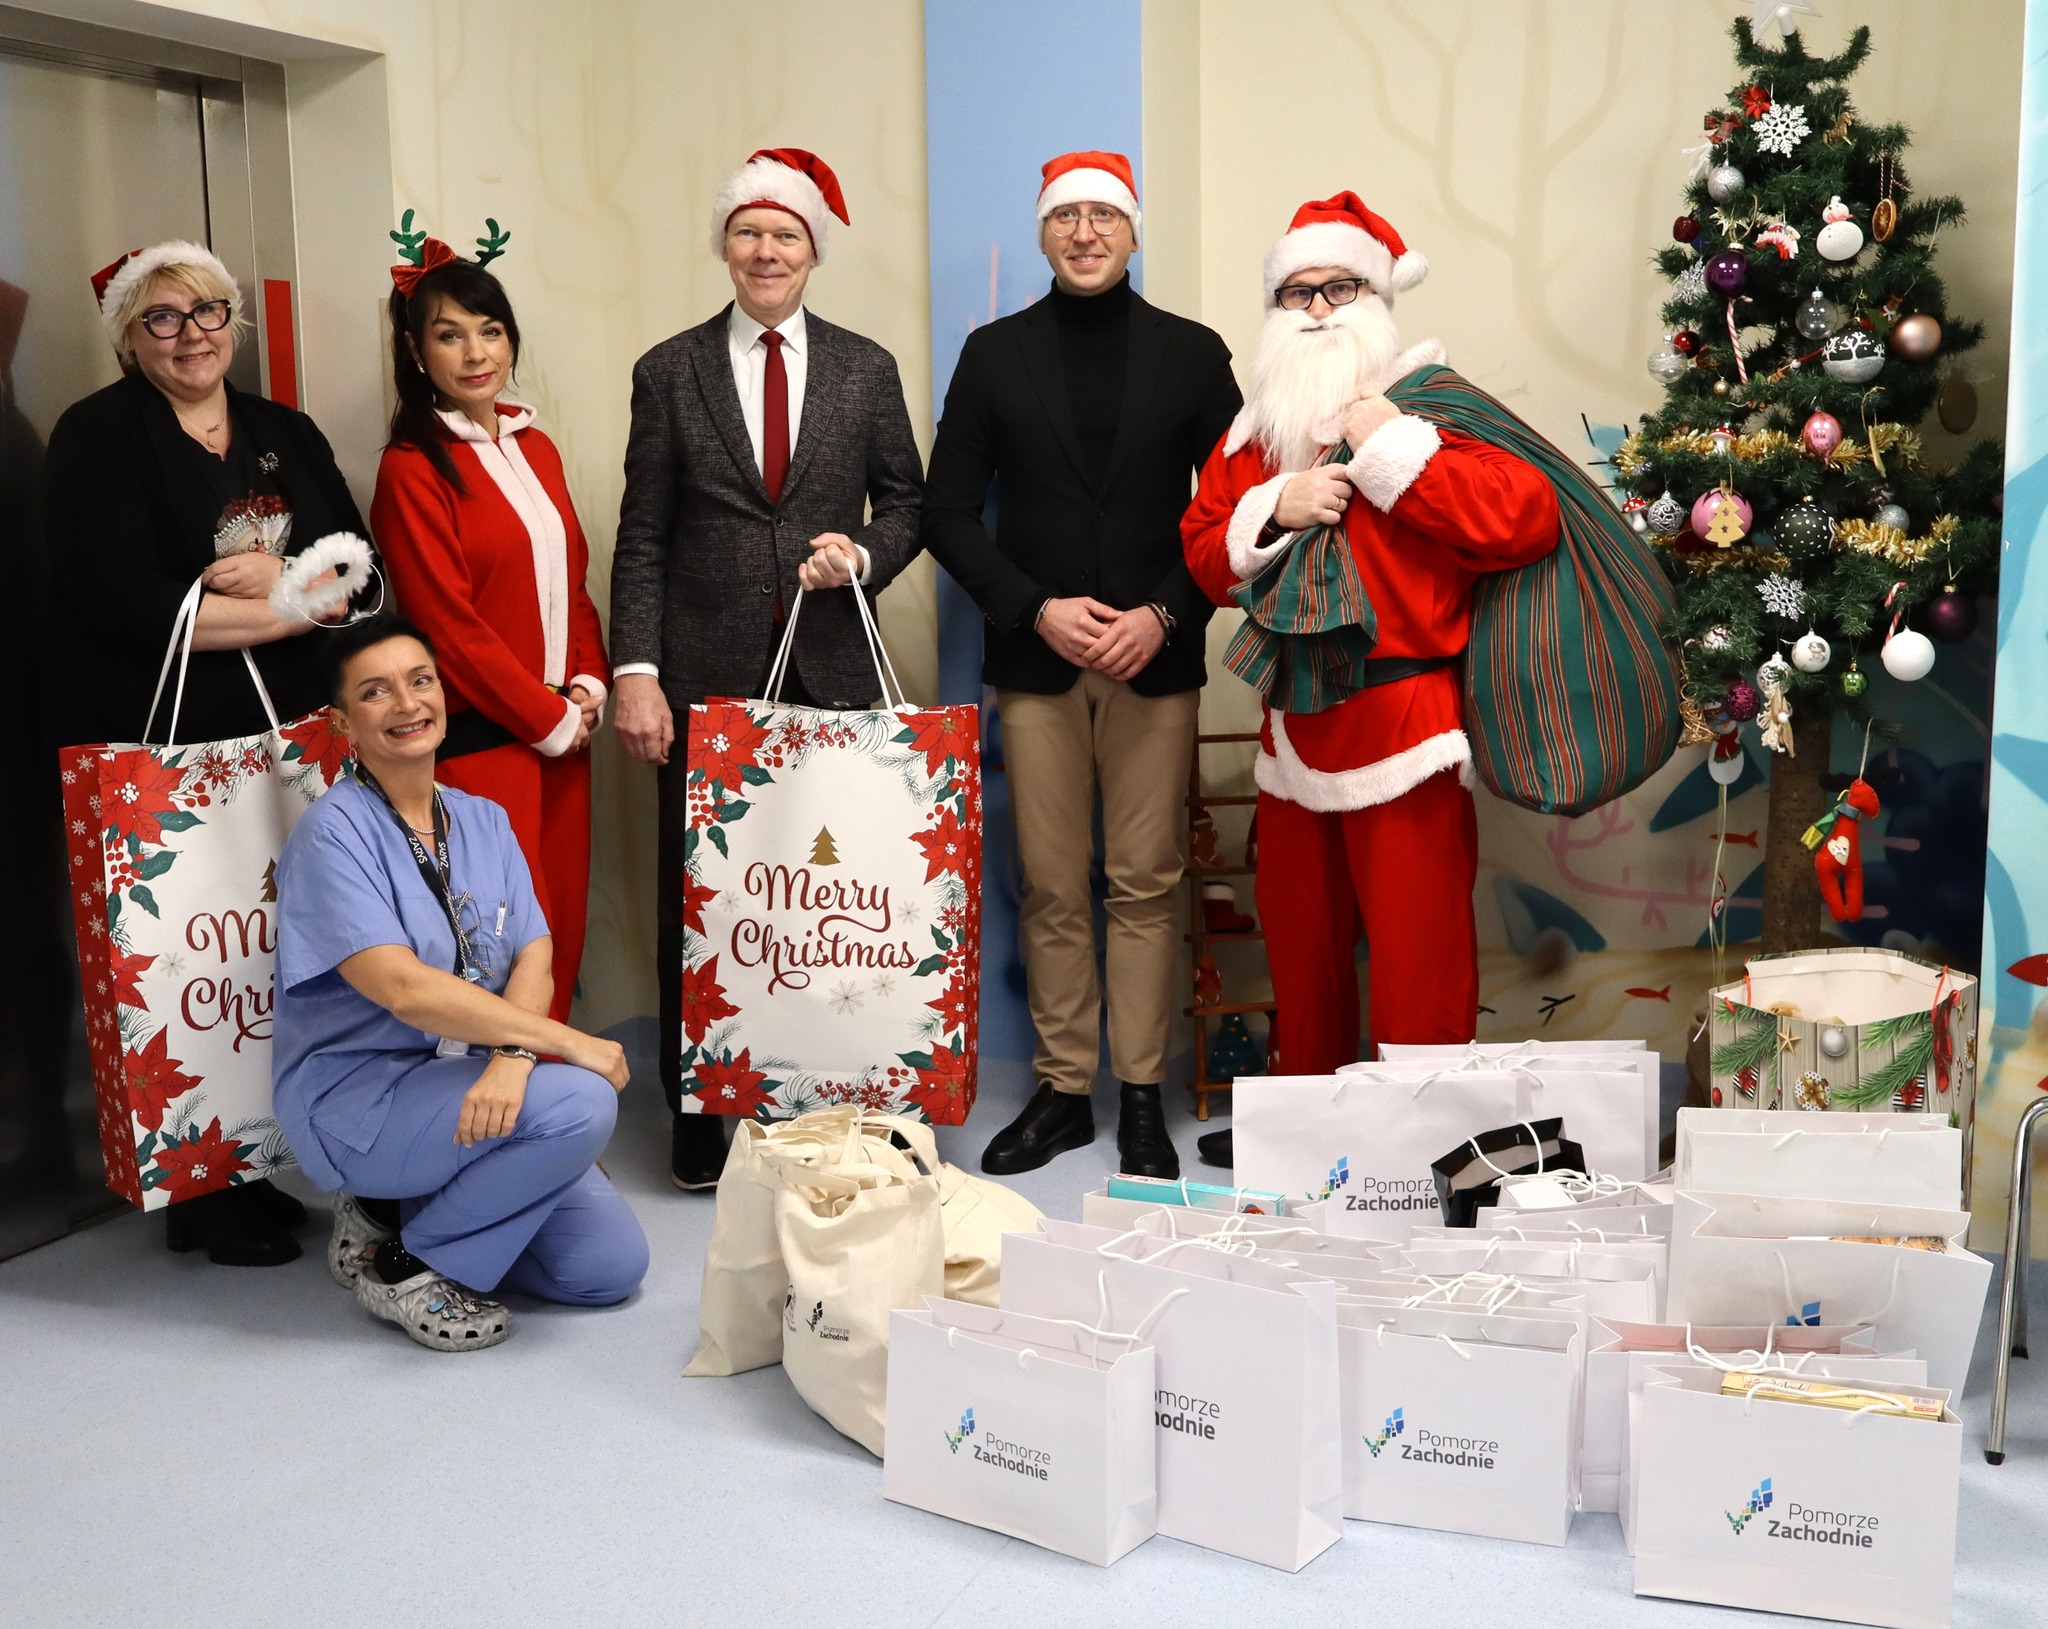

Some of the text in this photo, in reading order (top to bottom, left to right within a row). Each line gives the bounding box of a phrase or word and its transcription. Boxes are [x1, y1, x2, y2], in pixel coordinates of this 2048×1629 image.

[409, 836, 428, 864] ZARYS
[438, 841, 449, 868] ZARYS
[744, 861, 891, 943] Merry
[731, 918, 919, 996] Christmas
[1363, 1177, 1437, 1193] Pomorz
[1345, 1194, 1439, 1211] Zachodnie
[819, 1330, 849, 1342] Zachodnie
[986, 1432, 1051, 1465] Pomorze
[1418, 1429, 1499, 1453] Pomorze
[973, 1444, 1048, 1481] Zachodnie
[1401, 1444, 1495, 1469] Zachodnie
[1788, 1502, 1879, 1530] Pomorze
[1767, 1520, 1873, 1548] Zachodnie
